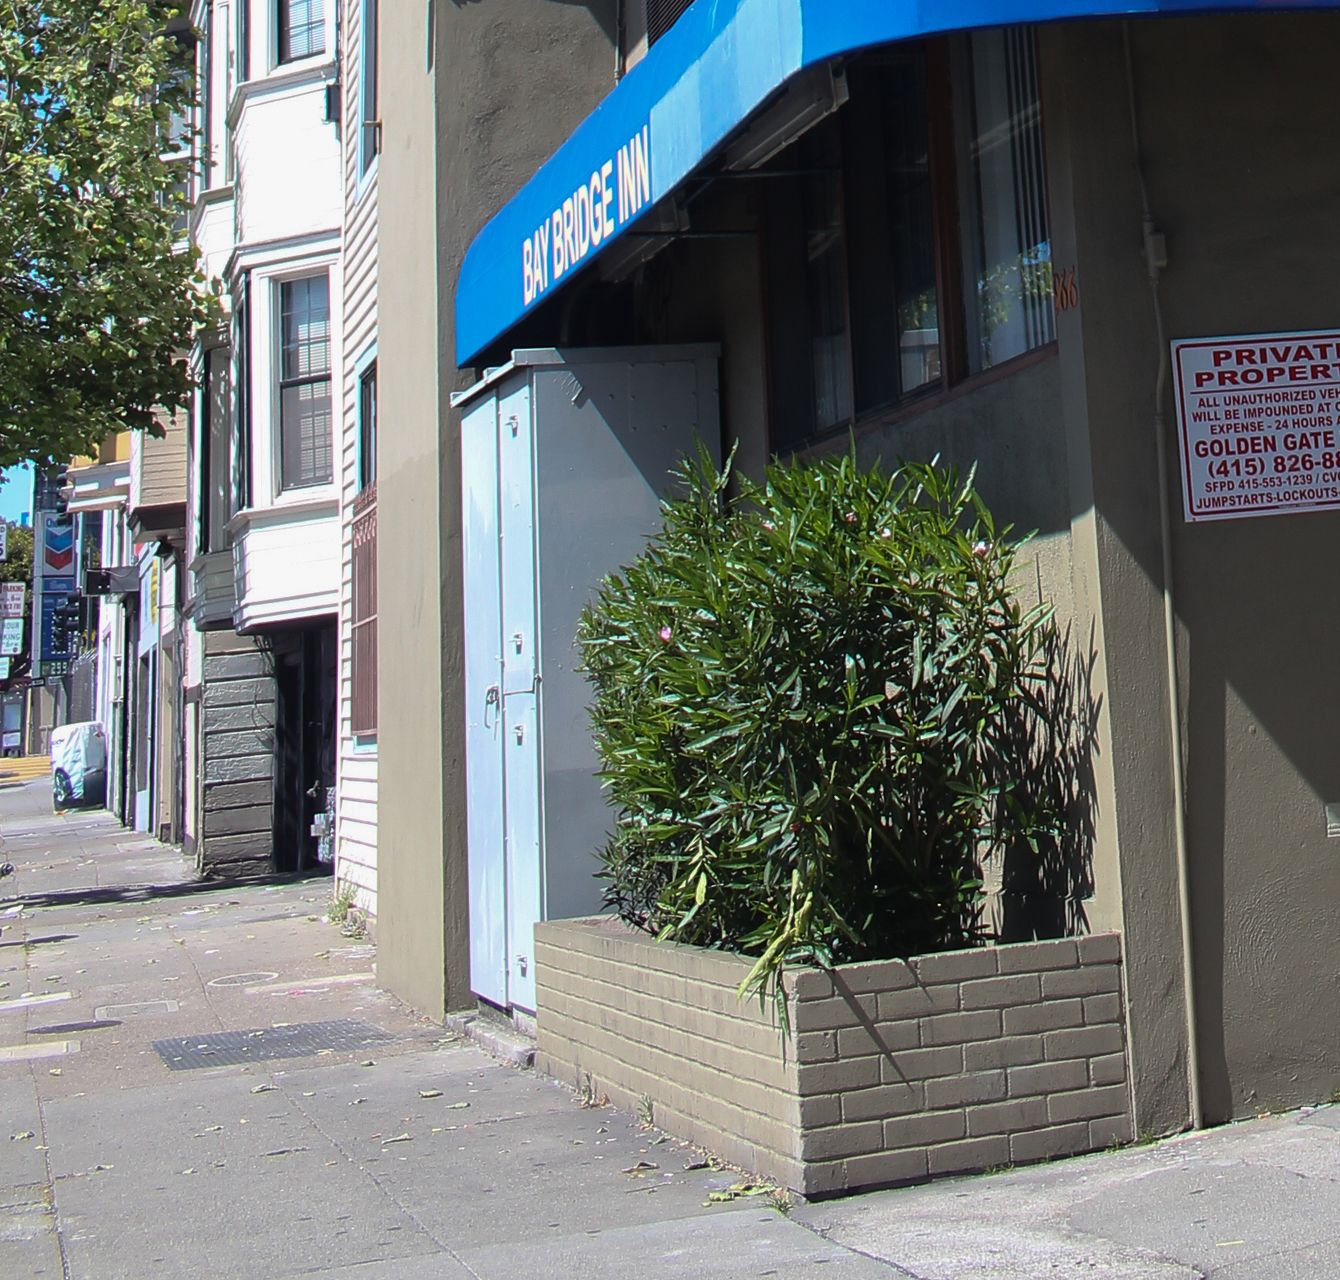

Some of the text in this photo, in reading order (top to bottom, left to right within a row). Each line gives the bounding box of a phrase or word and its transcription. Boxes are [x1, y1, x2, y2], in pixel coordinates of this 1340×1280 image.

[522, 124, 650, 306] BAY BRIDGE INN
[1198, 397, 1220, 408] ALL
[1224, 390, 1316, 407] UNAUTHORIZED
[1192, 411, 1221, 422] WILL
[1225, 409, 1240, 420] BE
[1244, 403, 1314, 419] IMPOUNDED
[1317, 402, 1332, 413] AT
[1210, 421, 1265, 435] EXPENSE
[1275, 419, 1289, 430] 24
[1292, 415, 1333, 428] HOURS
[1194, 435, 1277, 458] GOLDEN
[1283, 431, 1335, 450] GATE
[1208, 457, 1266, 478] (415)
[1205, 480, 1235, 493] SFPD
[1238, 473, 1313, 490] 415-553-1239
